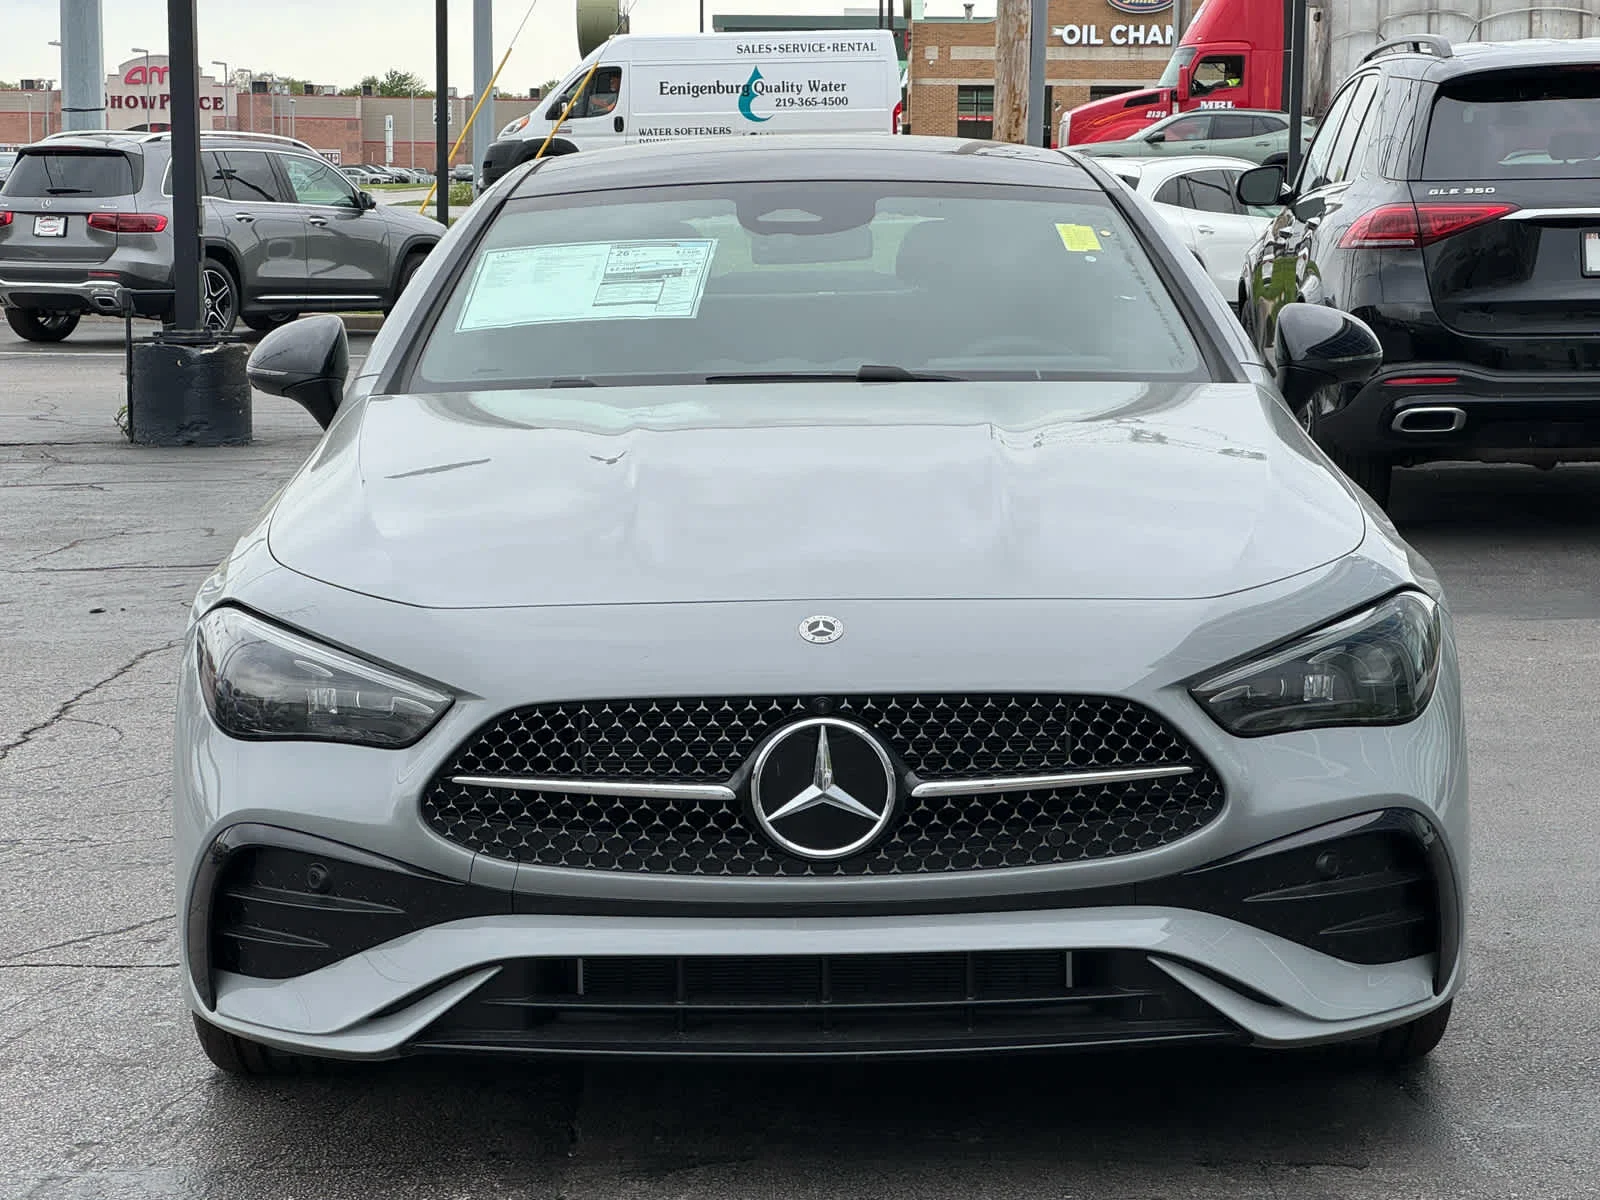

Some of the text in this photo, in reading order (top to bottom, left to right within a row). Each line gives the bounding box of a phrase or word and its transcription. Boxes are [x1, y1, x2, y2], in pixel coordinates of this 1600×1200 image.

[1062, 24, 1104, 45] OIL
[124, 66, 170, 85] am
[659, 80, 847, 97] Eenigenburg Quality Water
[775, 97, 849, 107] 219-365-4500
[638, 126, 732, 137] WATER SOFTENERS
